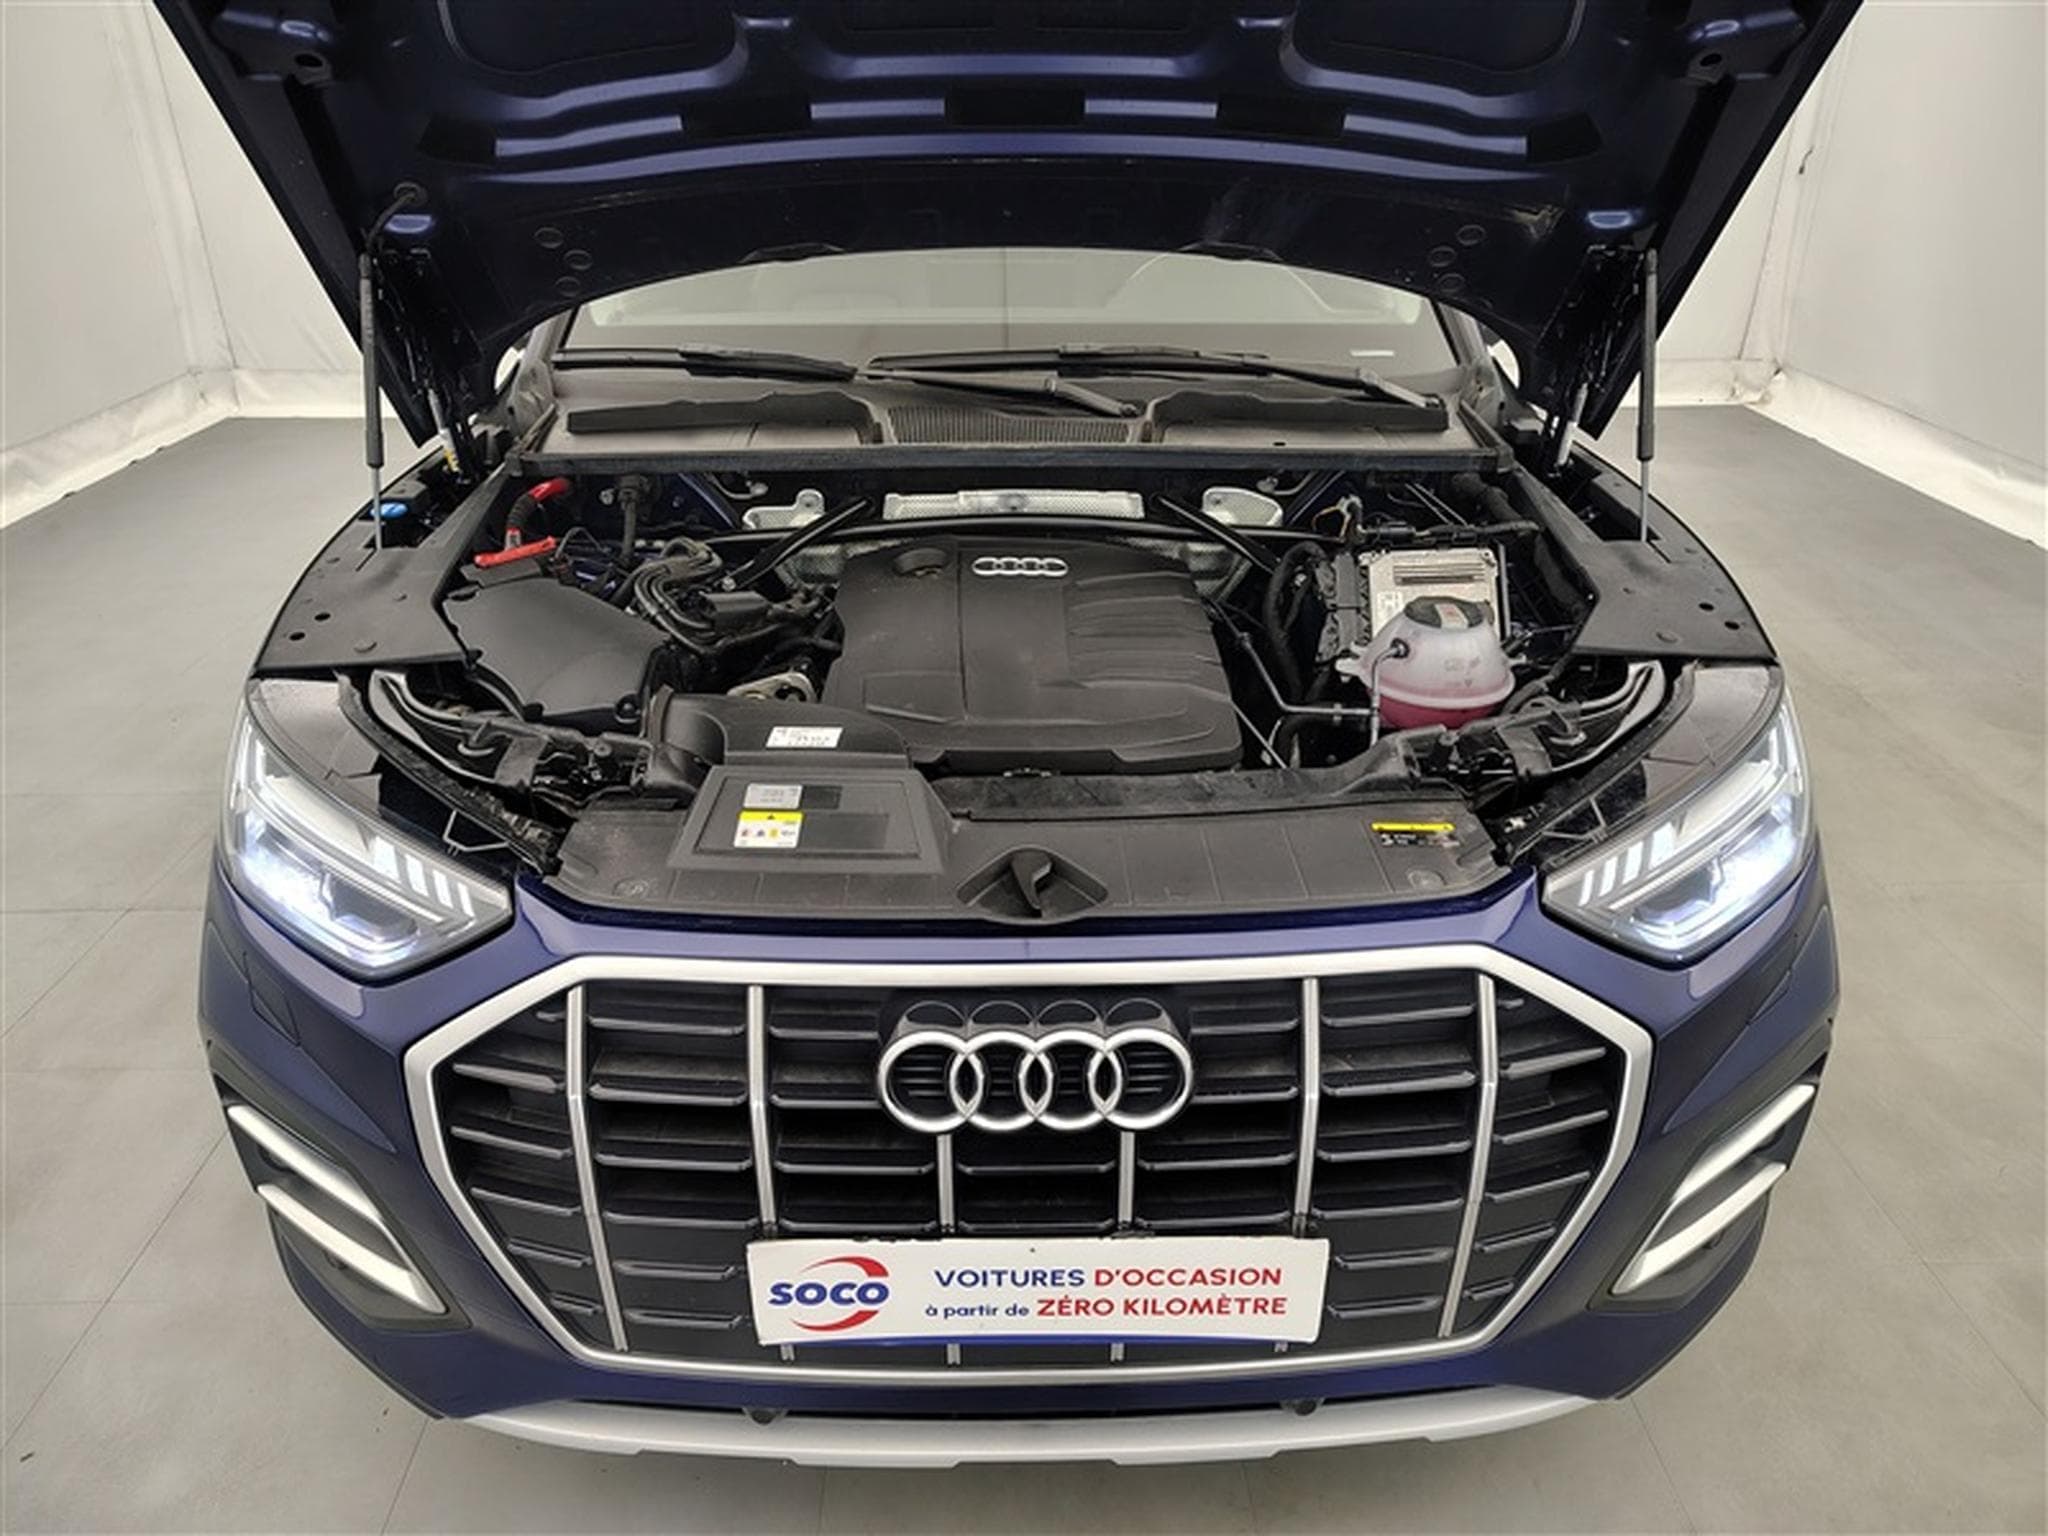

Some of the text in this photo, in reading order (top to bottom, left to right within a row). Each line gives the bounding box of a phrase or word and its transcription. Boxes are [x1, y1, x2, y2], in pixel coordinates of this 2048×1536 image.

[934, 1268, 1282, 1288] VOITURES D'OCCASION
[768, 1281, 890, 1307] SOCO
[925, 1293, 1288, 1320] à partir de ZÉRO KILOMÈTRE
